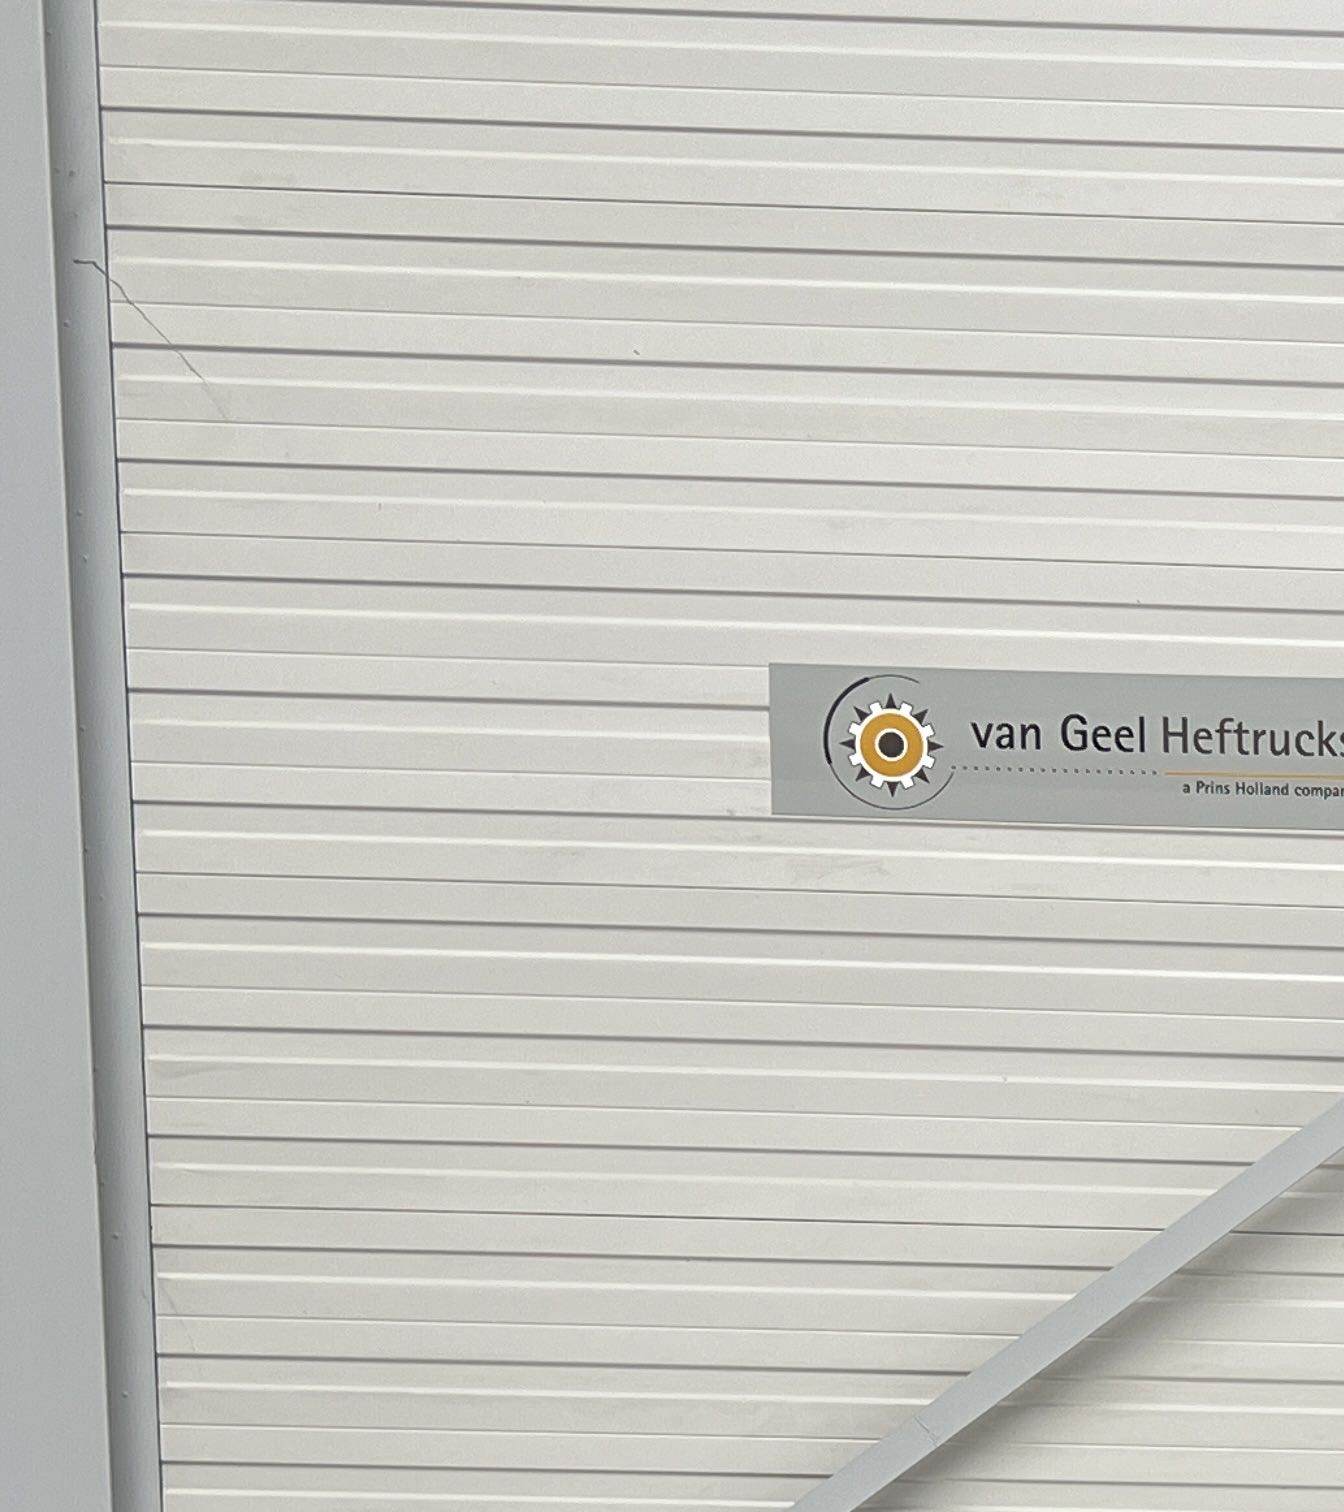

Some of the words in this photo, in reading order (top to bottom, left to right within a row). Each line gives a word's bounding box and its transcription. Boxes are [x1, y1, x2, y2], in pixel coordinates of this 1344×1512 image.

[970, 717, 1042, 751] van
[1060, 712, 1146, 754] Geel
[1182, 783, 1191, 795] a
[1195, 779, 1231, 796] Prins
[1235, 780, 1290, 797] Holland
